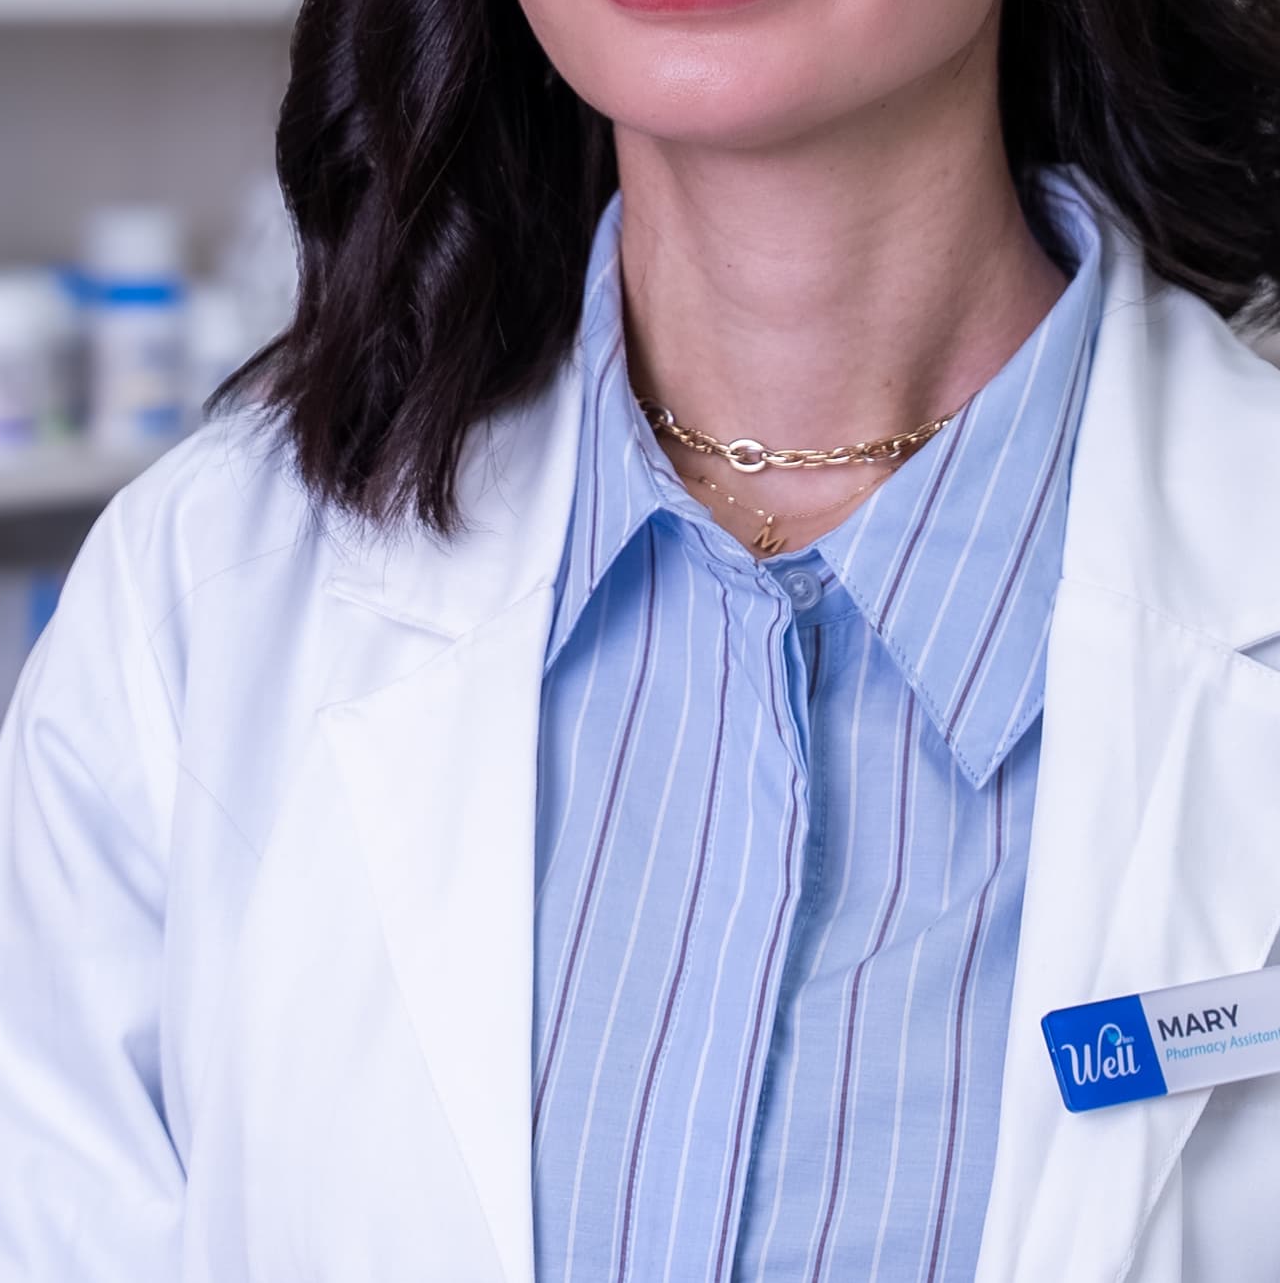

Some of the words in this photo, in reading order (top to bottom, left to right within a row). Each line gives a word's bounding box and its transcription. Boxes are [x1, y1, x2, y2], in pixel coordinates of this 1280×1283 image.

[753, 526, 785, 553] M
[1157, 1004, 1240, 1041] MARY
[1061, 1023, 1140, 1085] Well
[1166, 1039, 1226, 1061] Pharmacy
